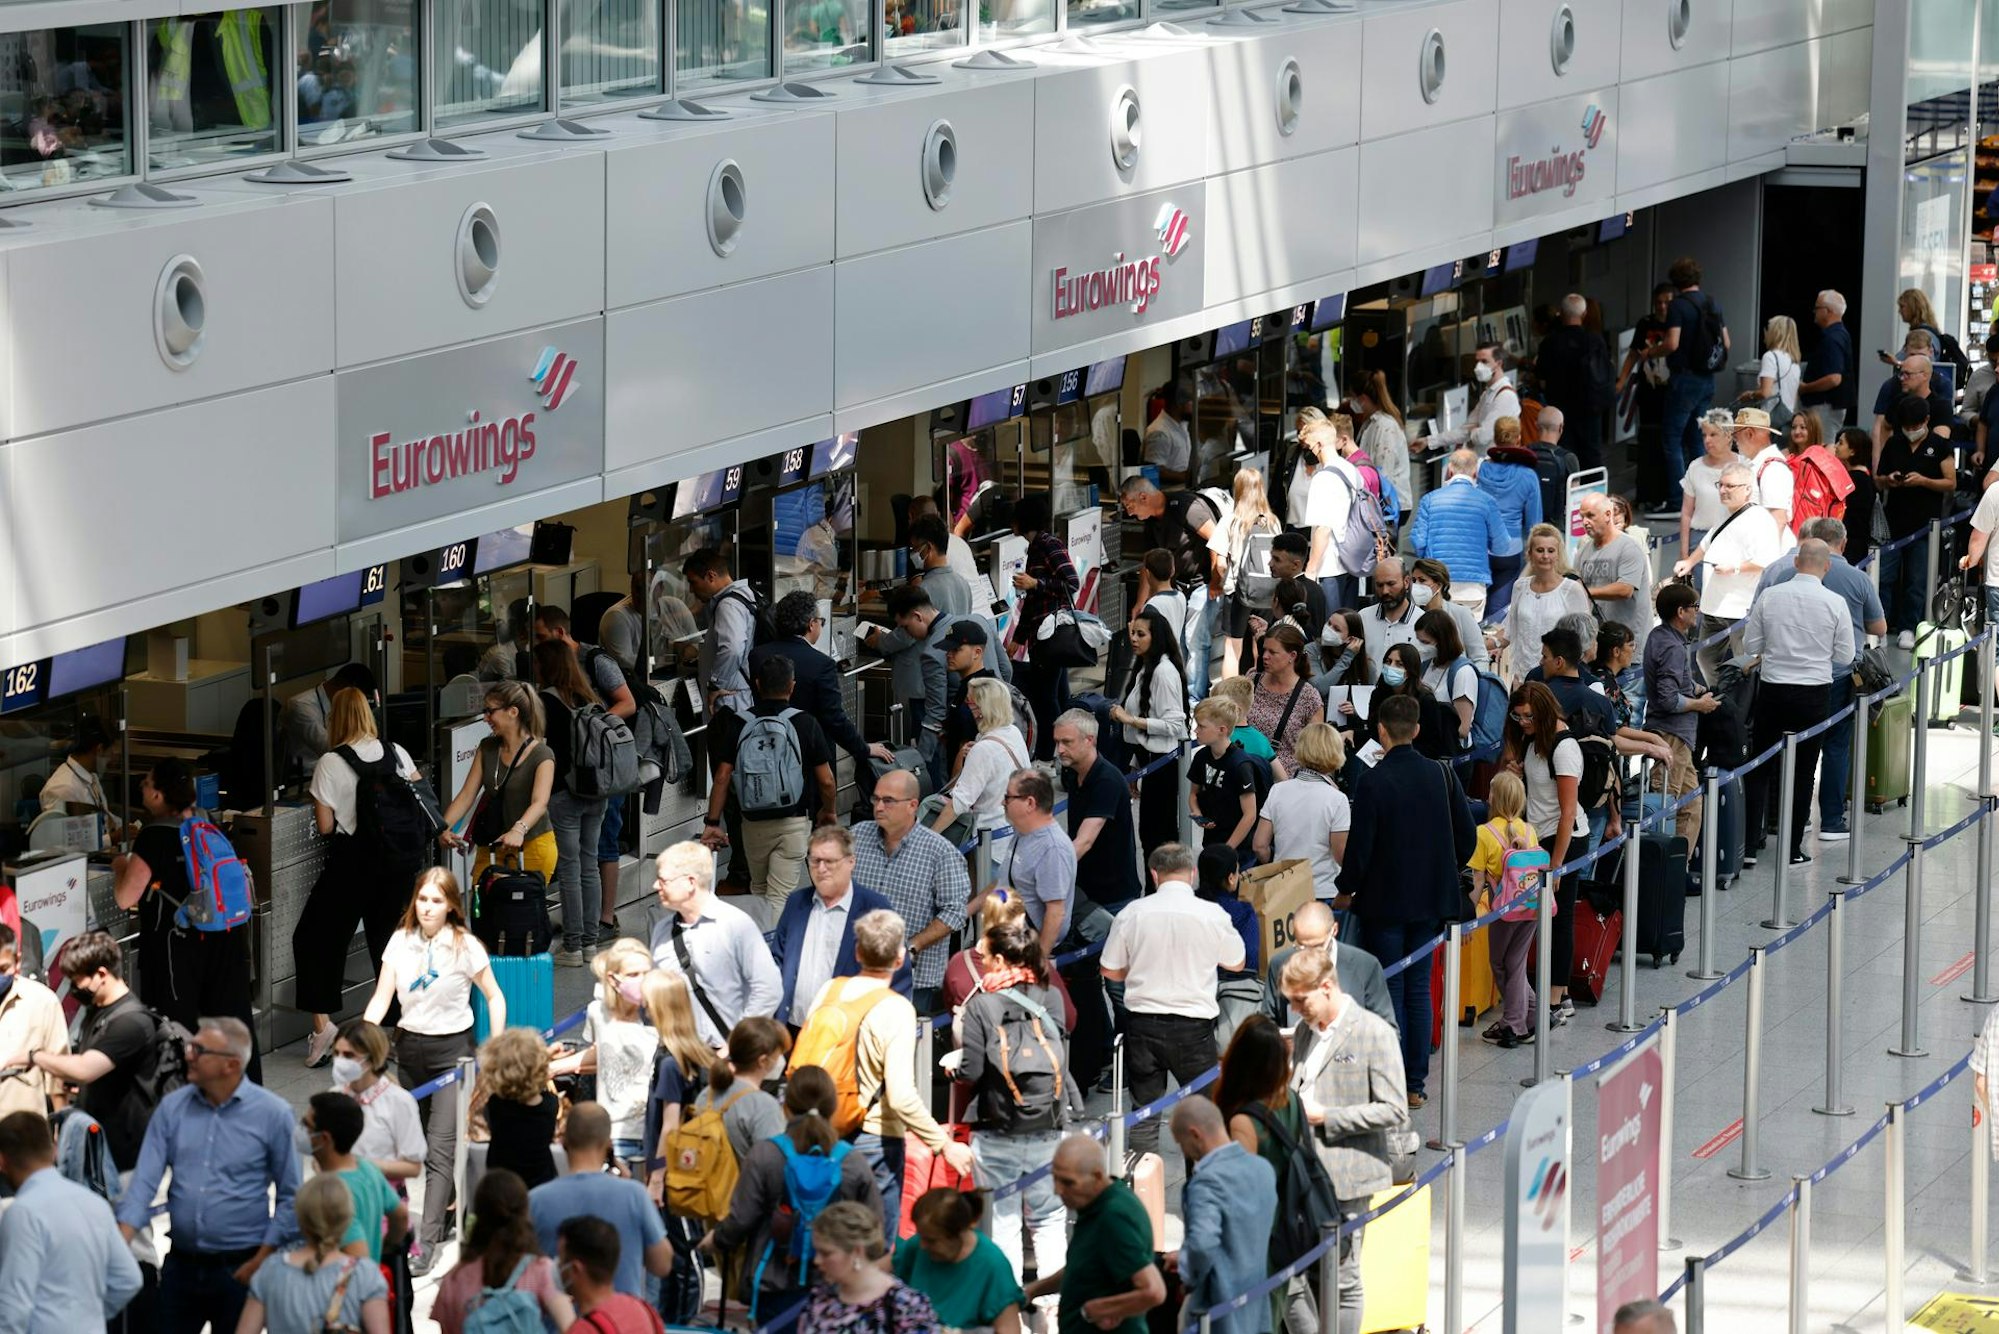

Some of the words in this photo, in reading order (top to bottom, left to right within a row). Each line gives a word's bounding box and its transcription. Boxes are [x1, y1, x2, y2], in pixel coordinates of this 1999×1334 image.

[1506, 144, 1585, 200] Eurowings
[1051, 252, 1160, 320] Eurowings
[1291, 304, 1307, 326] 154
[1061, 370, 1079, 393] 156
[368, 409, 536, 500] Eurowings
[783, 448, 804, 474] 158
[440, 543, 466, 573] 160
[363, 565, 384, 594] 61
[5, 663, 37, 698] 162
[23, 890, 67, 914] Eurowings
